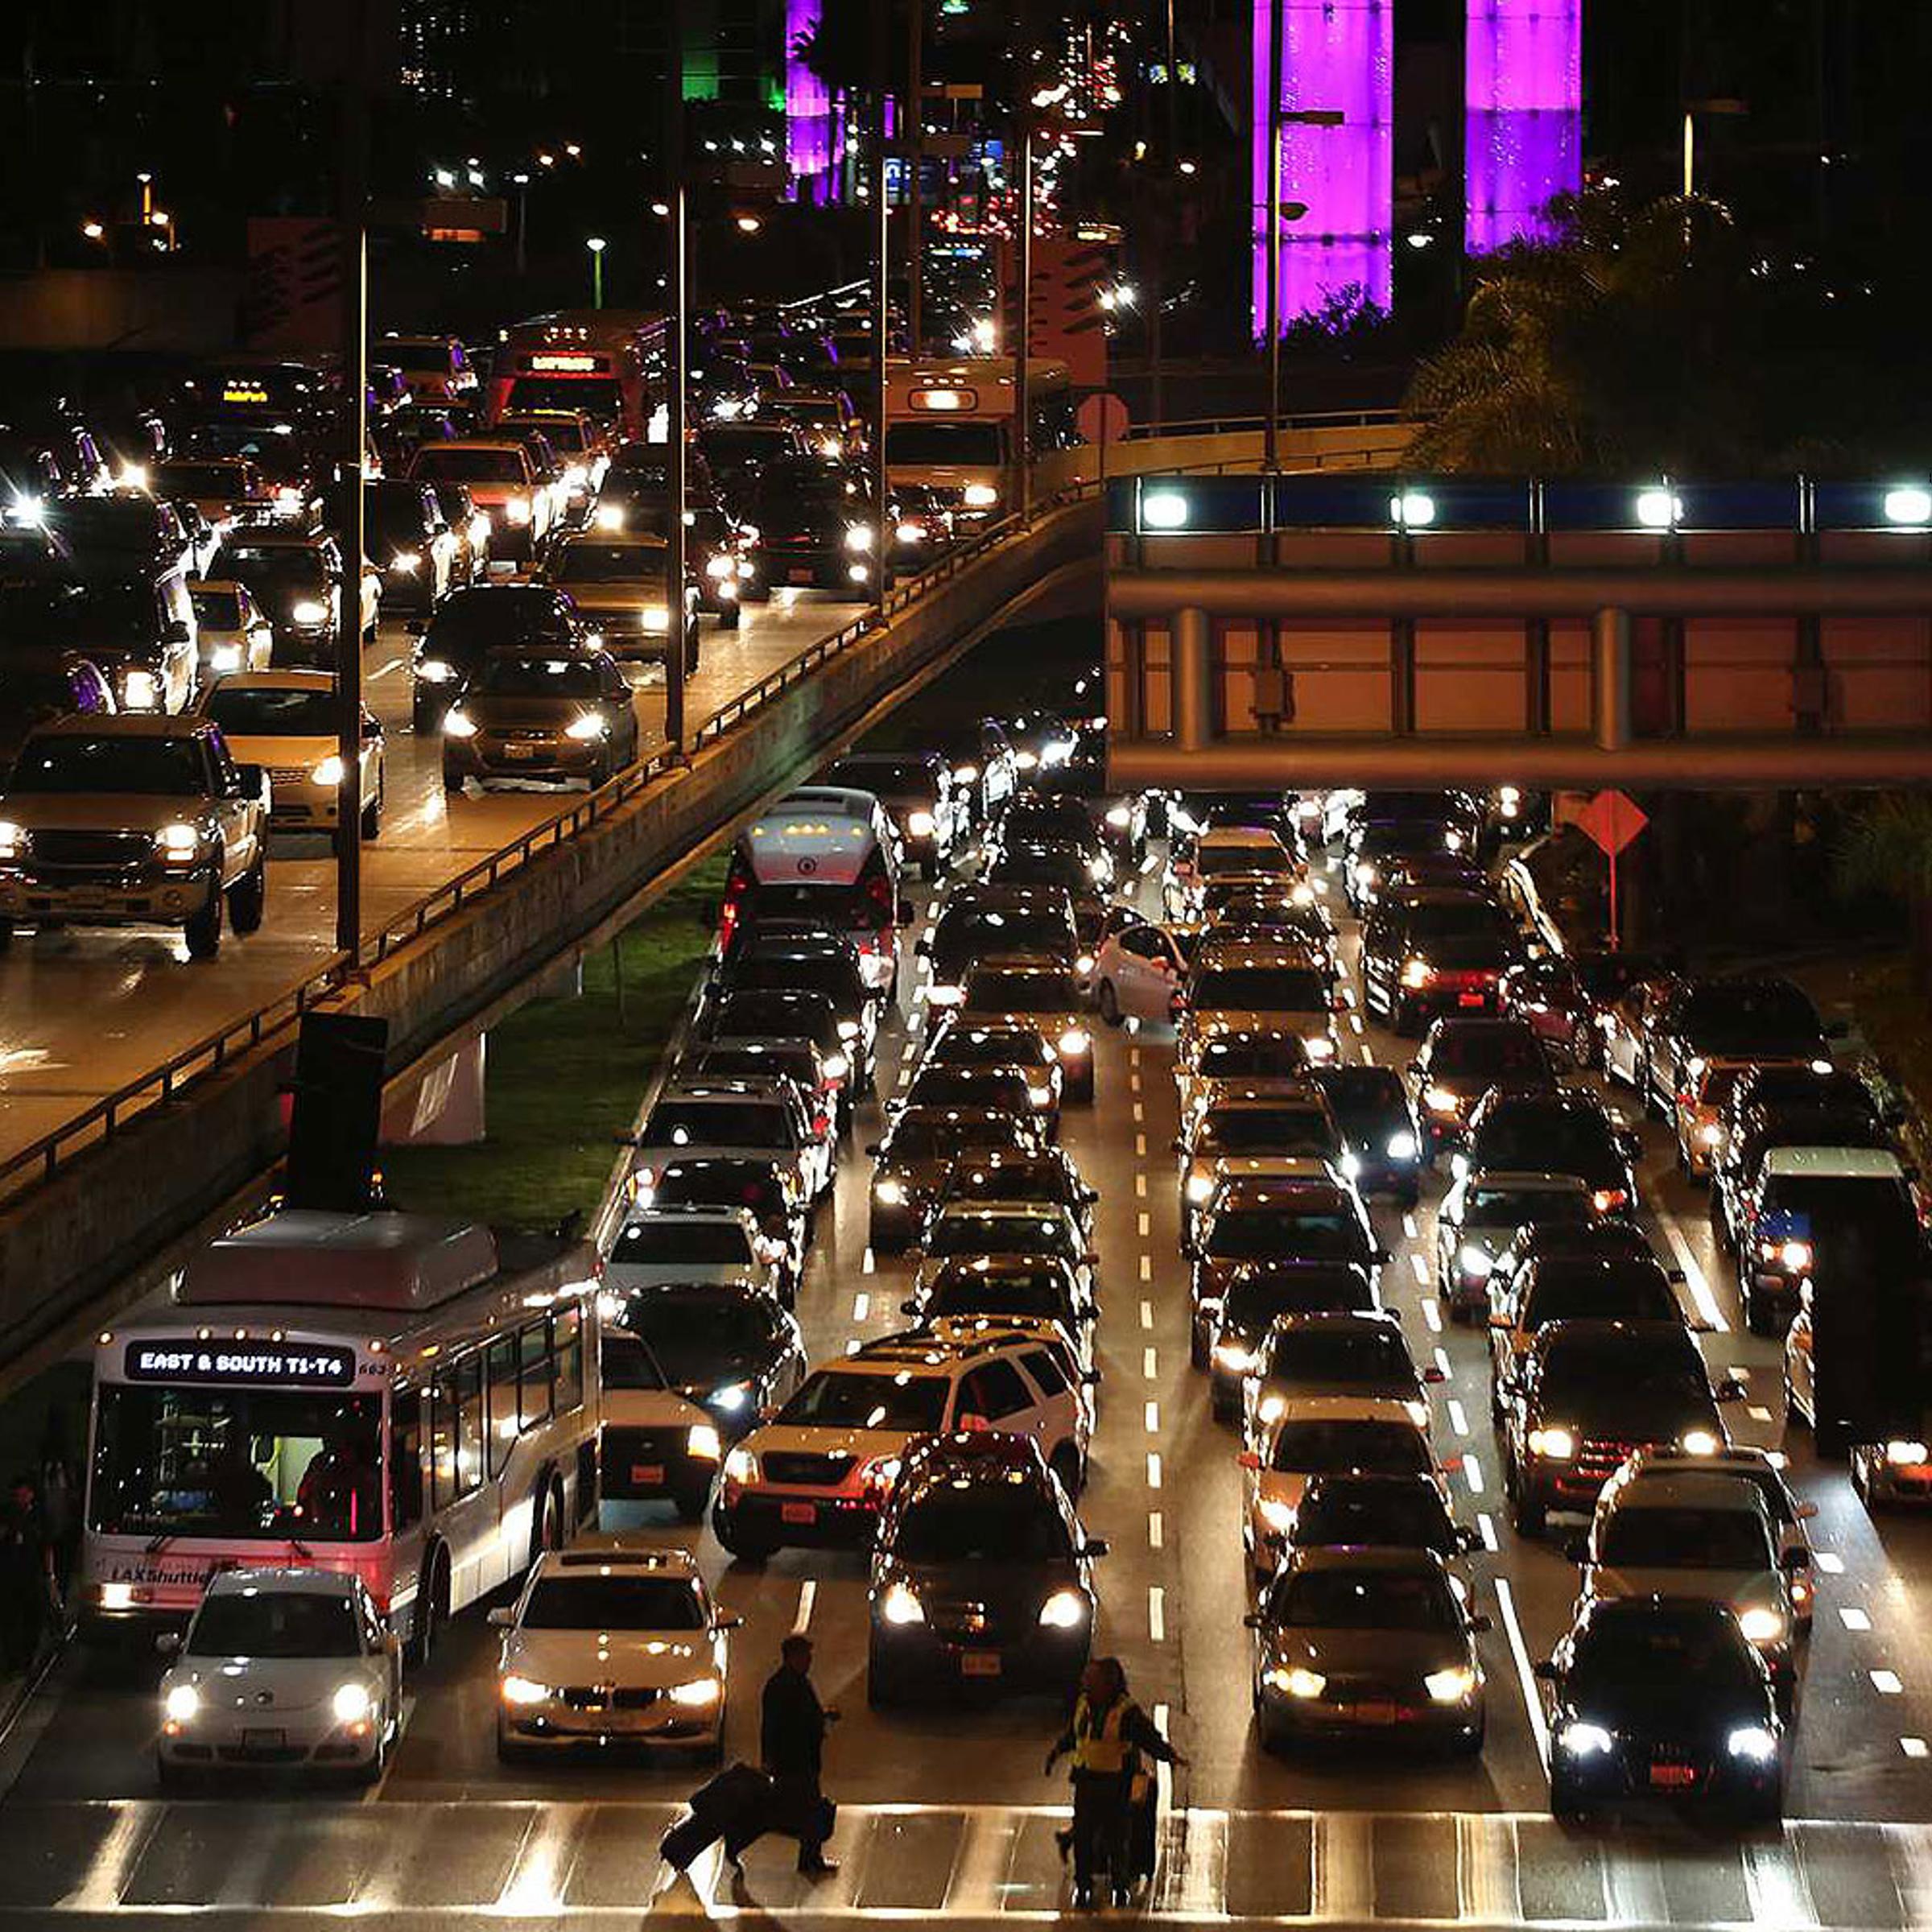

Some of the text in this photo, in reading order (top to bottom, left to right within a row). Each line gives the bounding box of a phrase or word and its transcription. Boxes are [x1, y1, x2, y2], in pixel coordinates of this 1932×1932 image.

[139, 1352, 194, 1369] EAST
[198, 1353, 212, 1371] &
[216, 1354, 283, 1373] SOUTH
